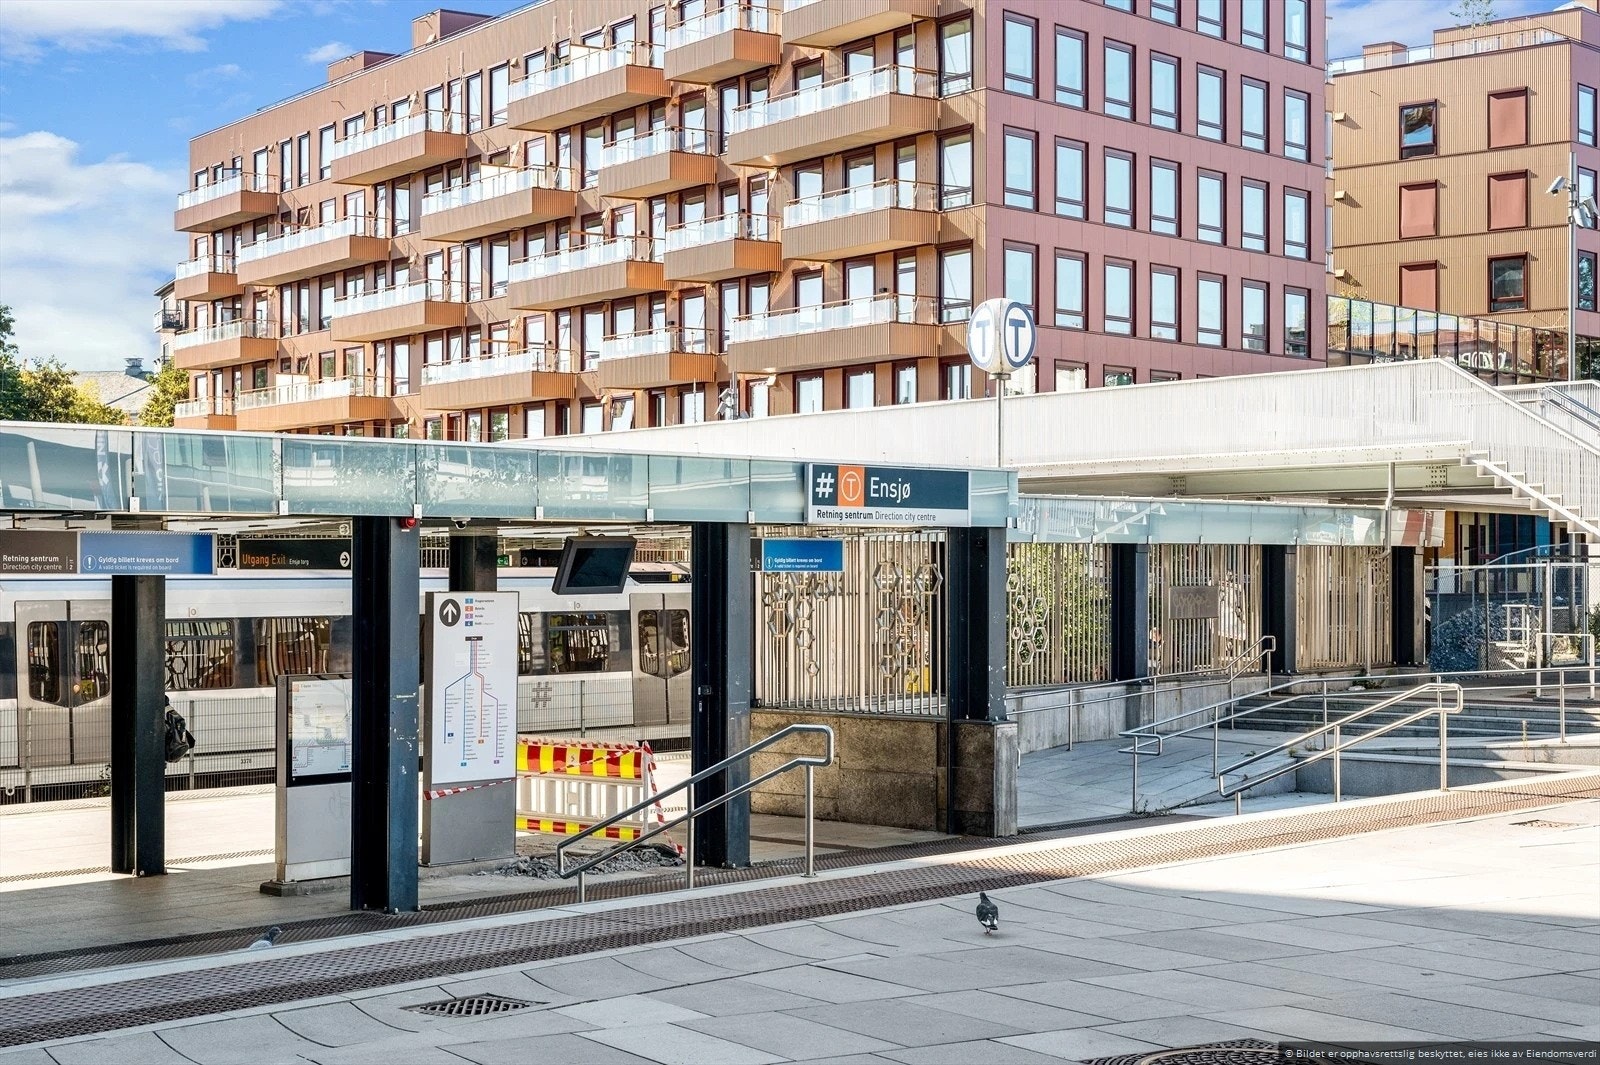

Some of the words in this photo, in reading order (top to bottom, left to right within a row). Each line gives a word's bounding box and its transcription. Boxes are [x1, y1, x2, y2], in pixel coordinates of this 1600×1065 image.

[1008, 318, 1026, 358] T
[870, 476, 911, 504] Ensjø
[816, 509, 843, 521] Retning
[844, 510, 874, 520] sentrum
[875, 511, 904, 520] Direction
[904, 512, 916, 522] city
[916, 512, 936, 522] centre
[2, 554, 29, 563] Retning
[242, 554, 270, 567] Utgang
[272, 554, 286, 564] Exit
